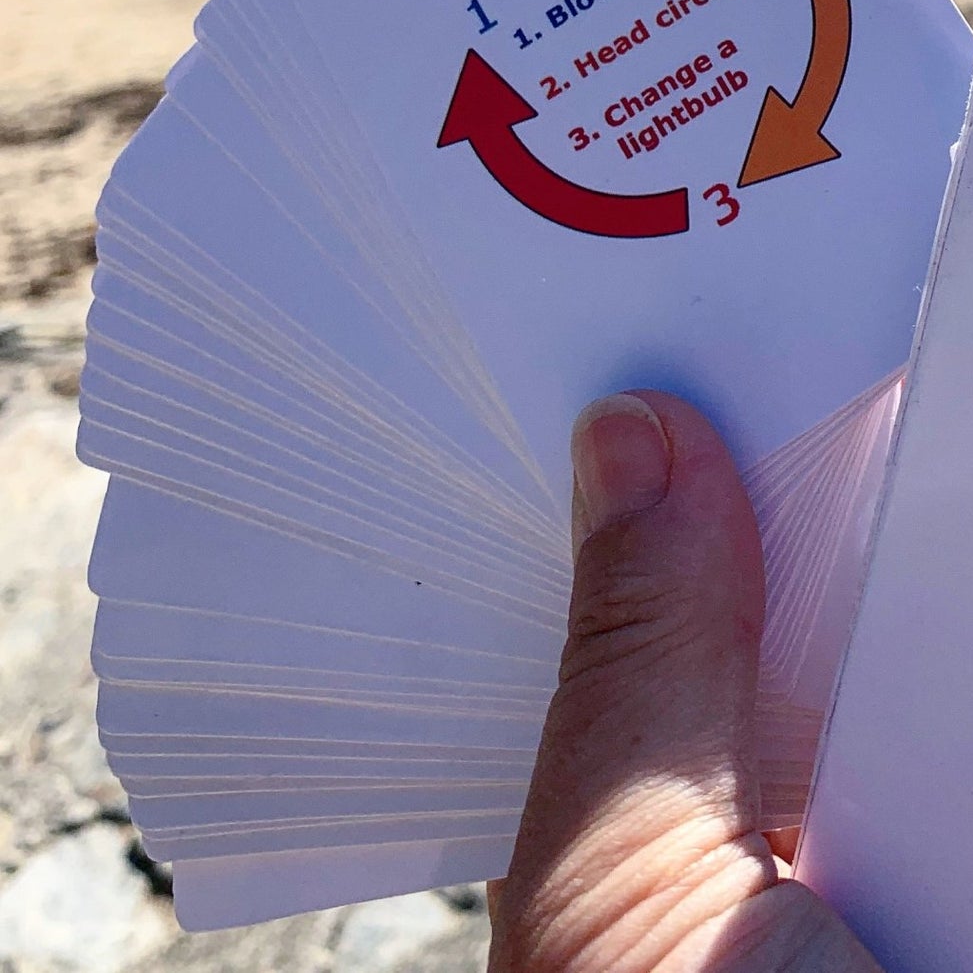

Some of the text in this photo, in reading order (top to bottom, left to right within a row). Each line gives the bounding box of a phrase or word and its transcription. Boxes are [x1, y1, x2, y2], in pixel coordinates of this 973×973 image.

[513, 28, 542, 49] 1.
[539, 77, 571, 100] 2.
[574, 20, 650, 78] Head
[568, 38, 738, 151] 3. Change a
[617, 69, 749, 159] lightbulb
[703, 183, 740, 226] 3
